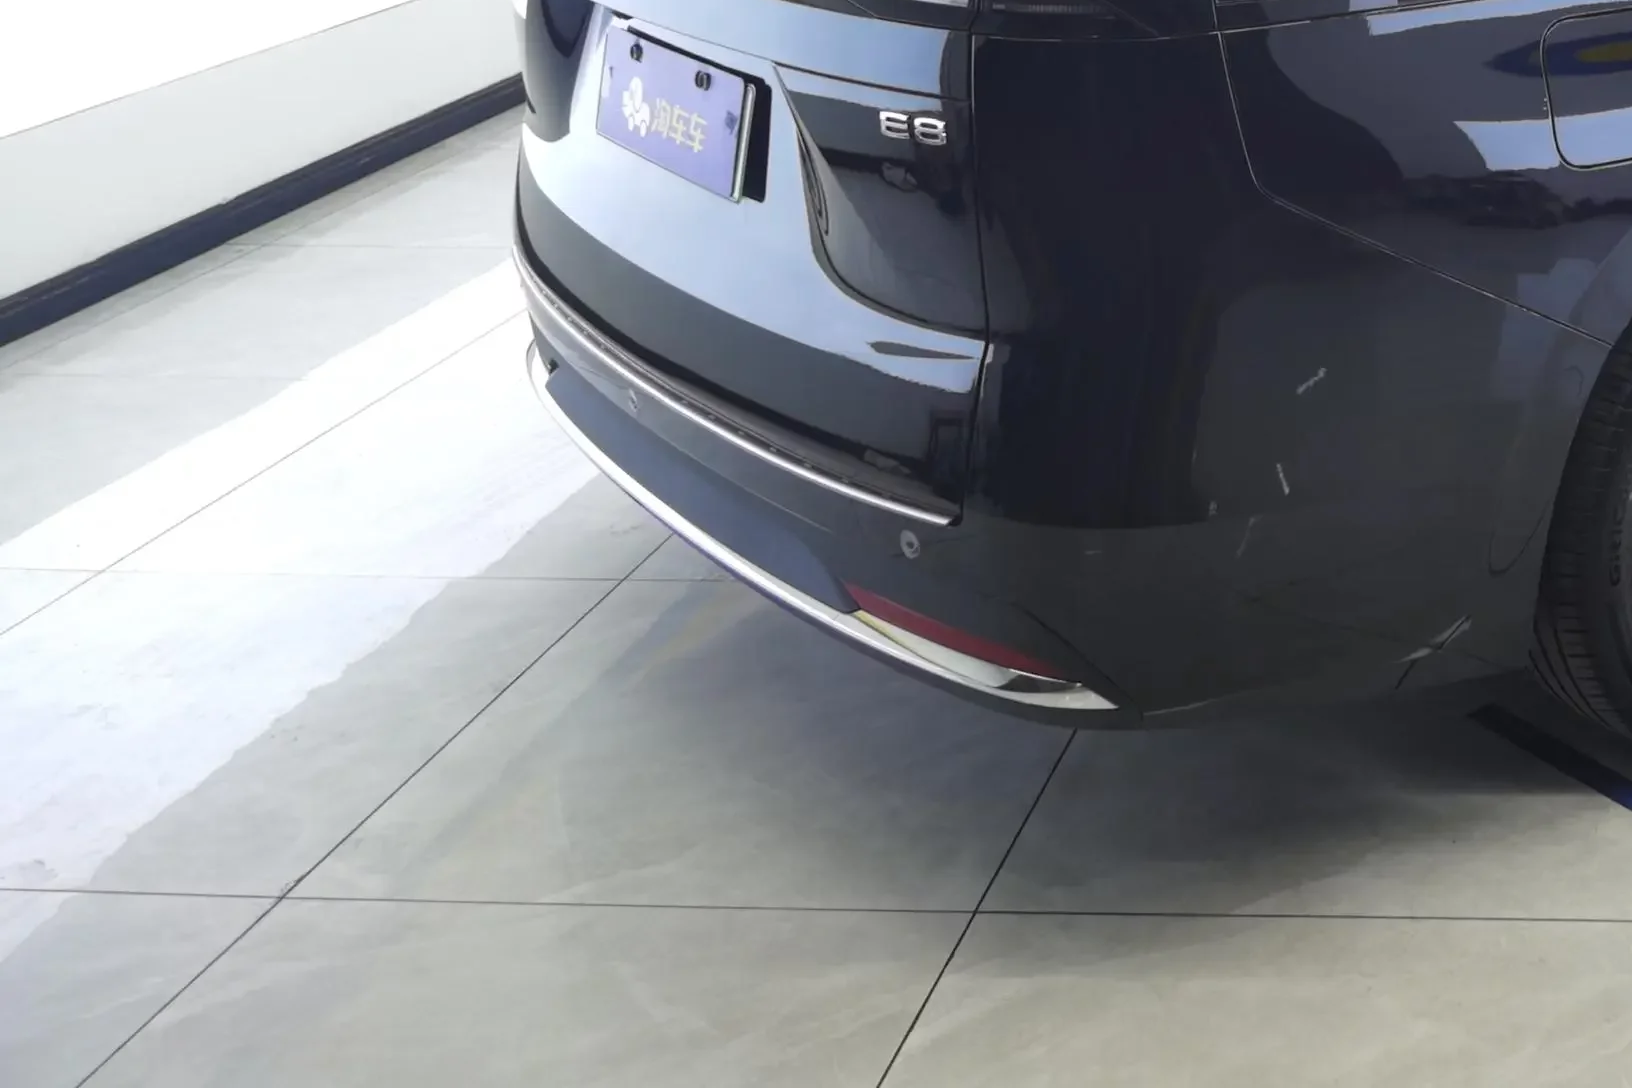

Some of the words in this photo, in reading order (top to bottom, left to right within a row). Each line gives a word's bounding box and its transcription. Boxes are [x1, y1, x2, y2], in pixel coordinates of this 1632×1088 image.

[651, 98, 708, 152] 淘车车
[880, 111, 947, 145] E8
